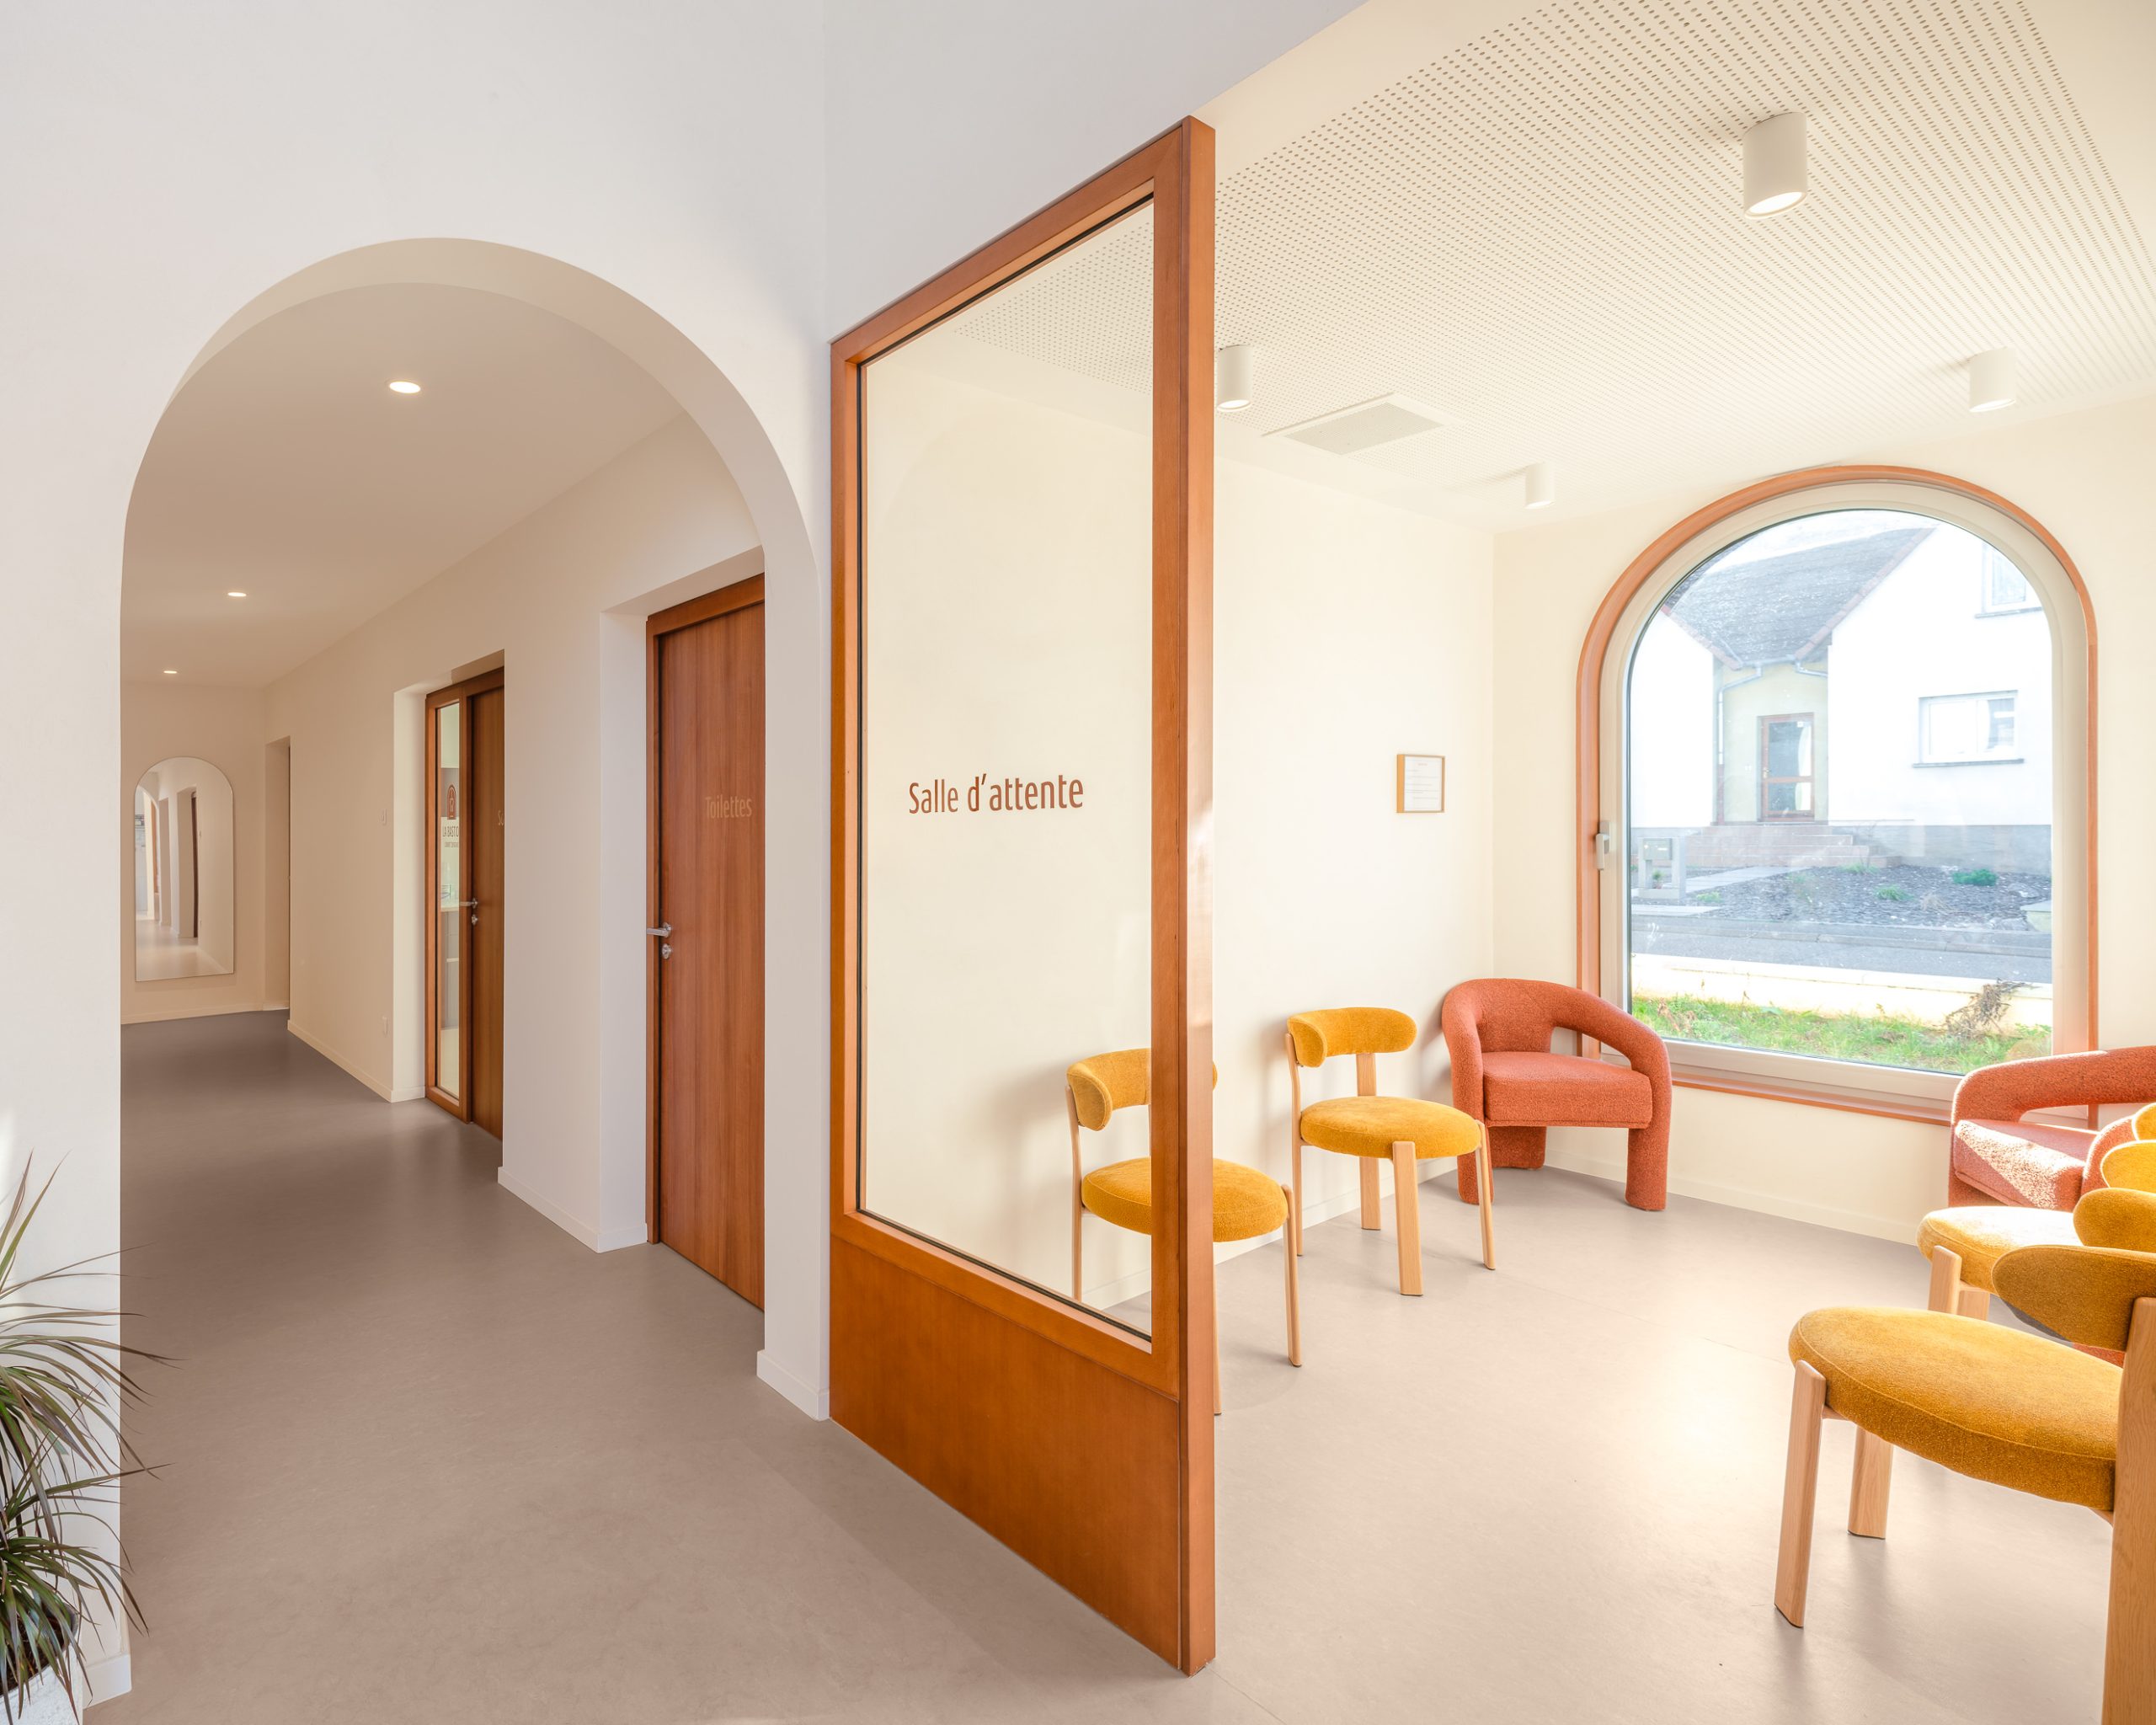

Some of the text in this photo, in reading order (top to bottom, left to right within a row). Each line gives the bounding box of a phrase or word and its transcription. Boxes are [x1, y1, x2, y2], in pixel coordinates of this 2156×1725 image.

[705, 793, 752, 819] Toilettes
[909, 773, 1084, 814] Salle d'attente
